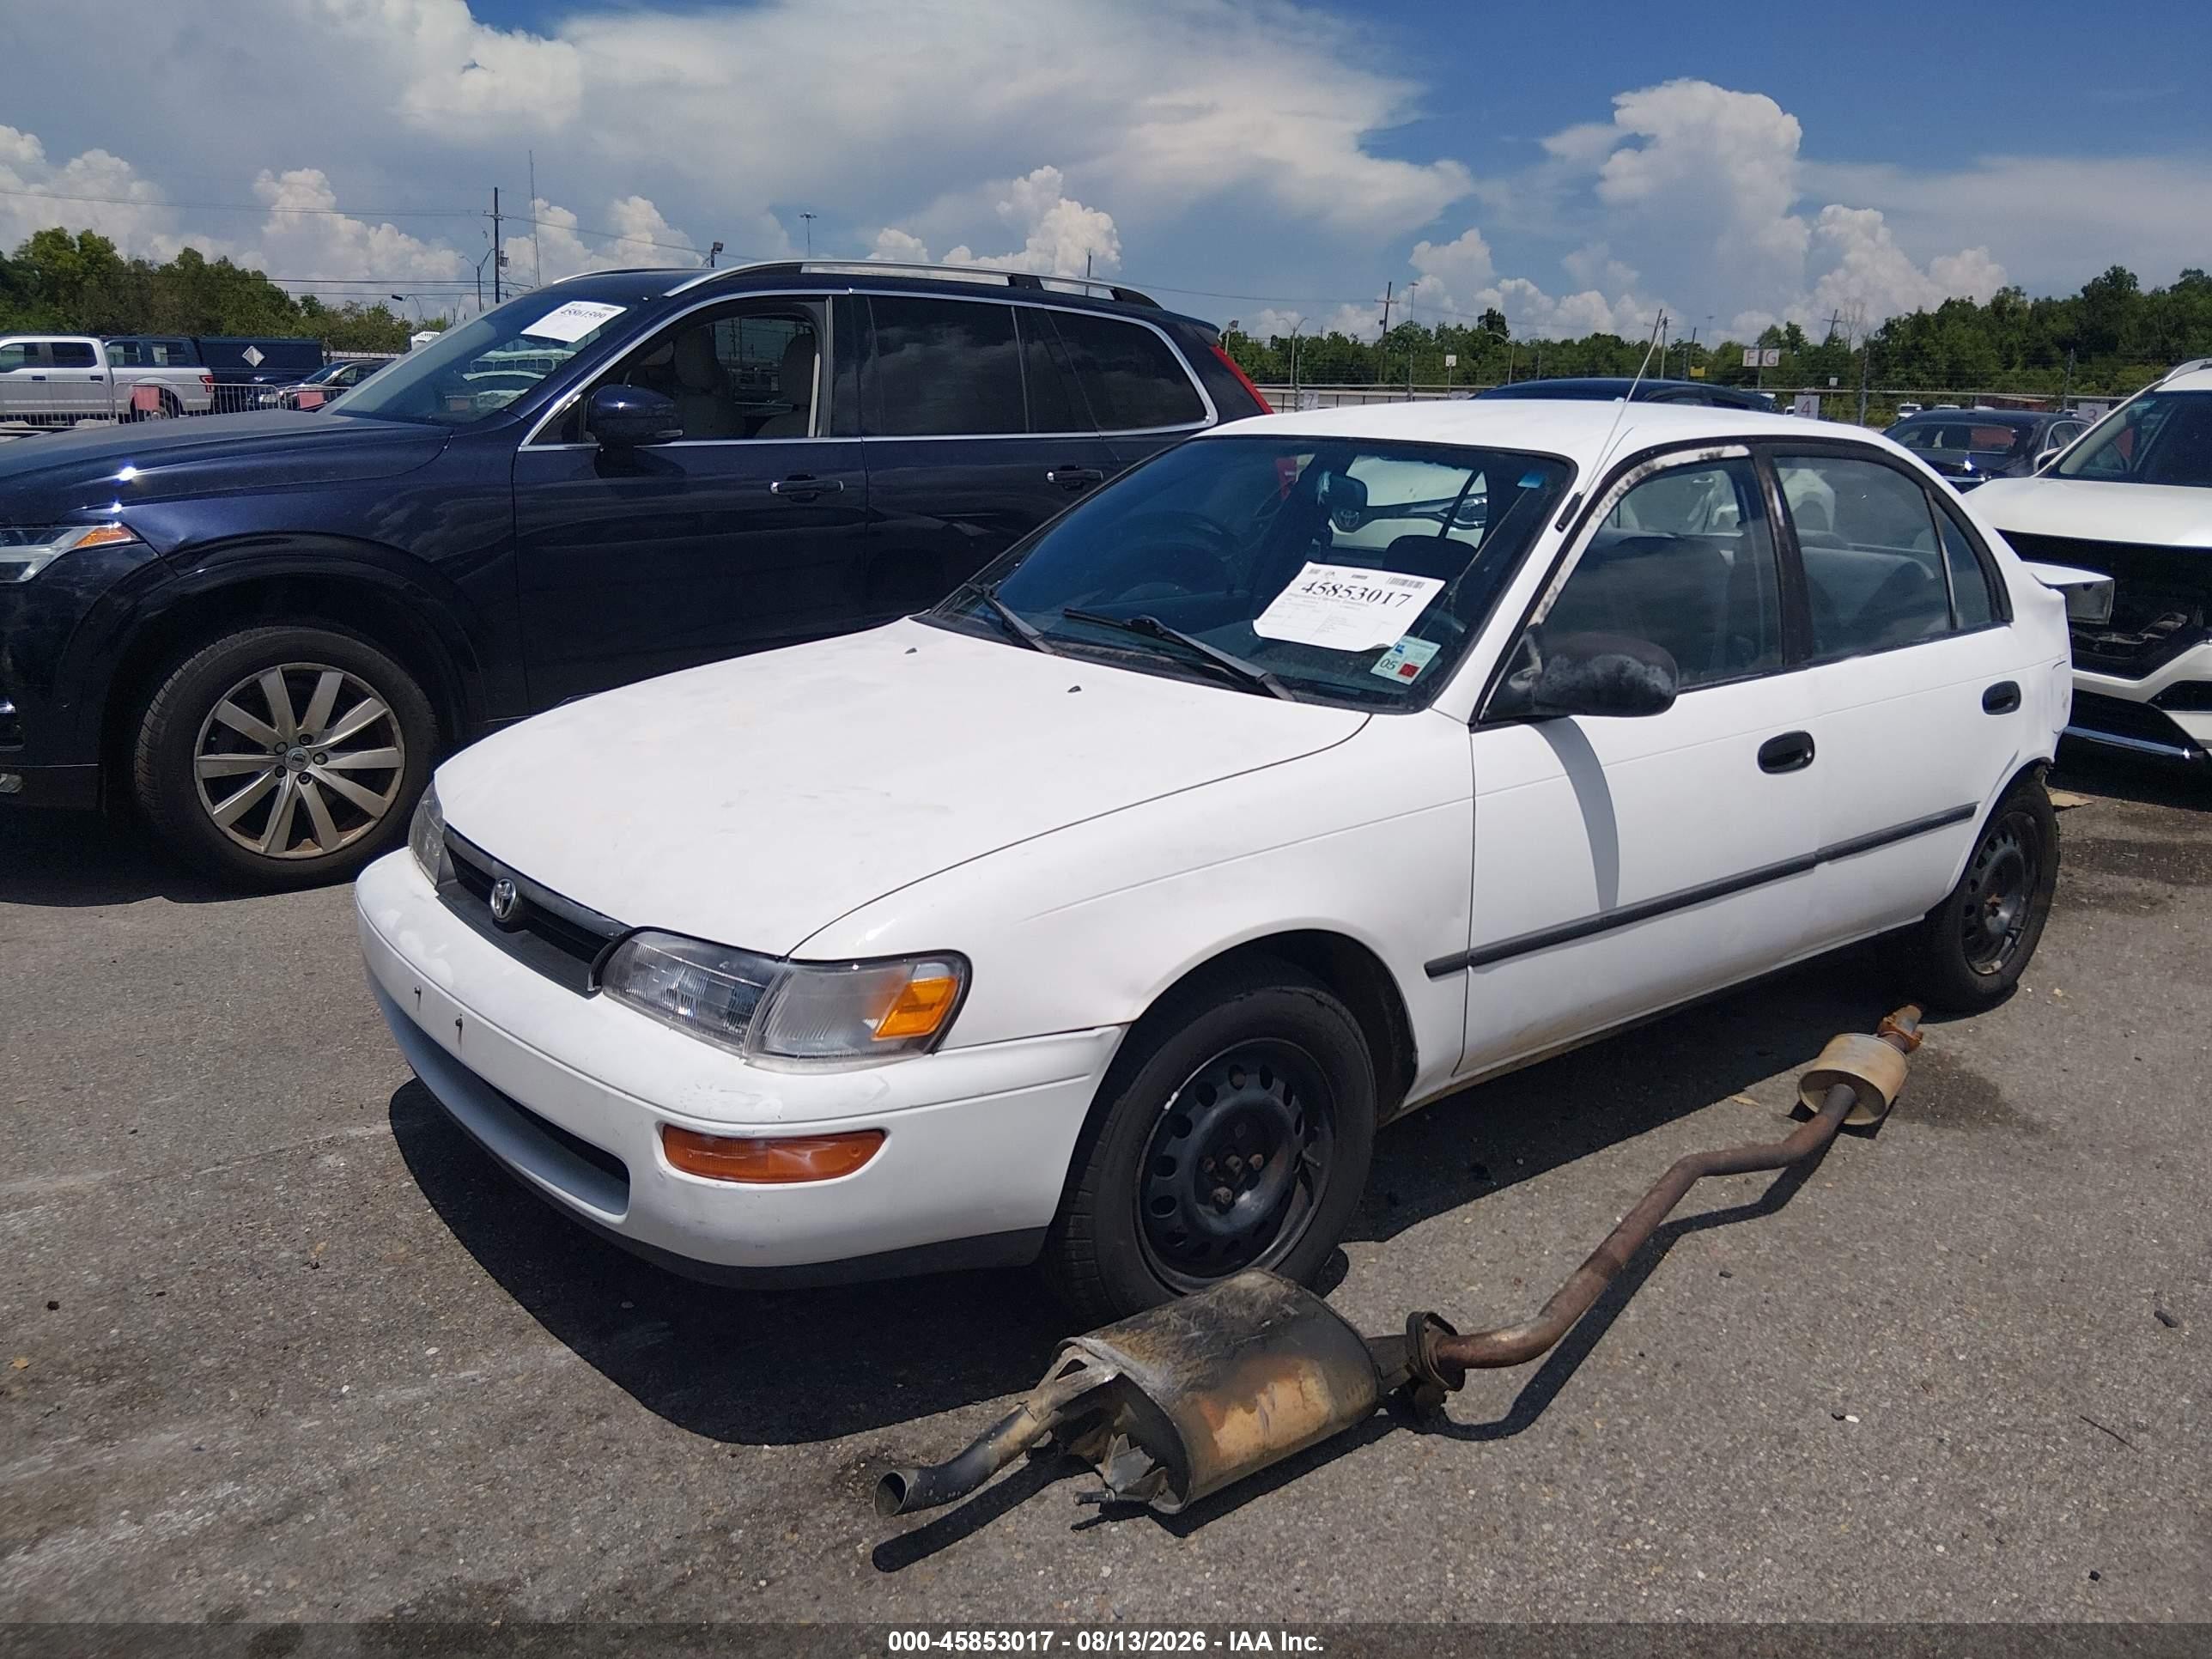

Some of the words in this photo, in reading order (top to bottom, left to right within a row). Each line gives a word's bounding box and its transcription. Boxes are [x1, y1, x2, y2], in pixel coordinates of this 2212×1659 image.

[1746, 350, 1755, 366] F
[1765, 349, 1777, 366] G
[1800, 399, 1811, 417] 4
[1301, 580, 1413, 608] 45853017
[1380, 658, 1399, 671] 05
